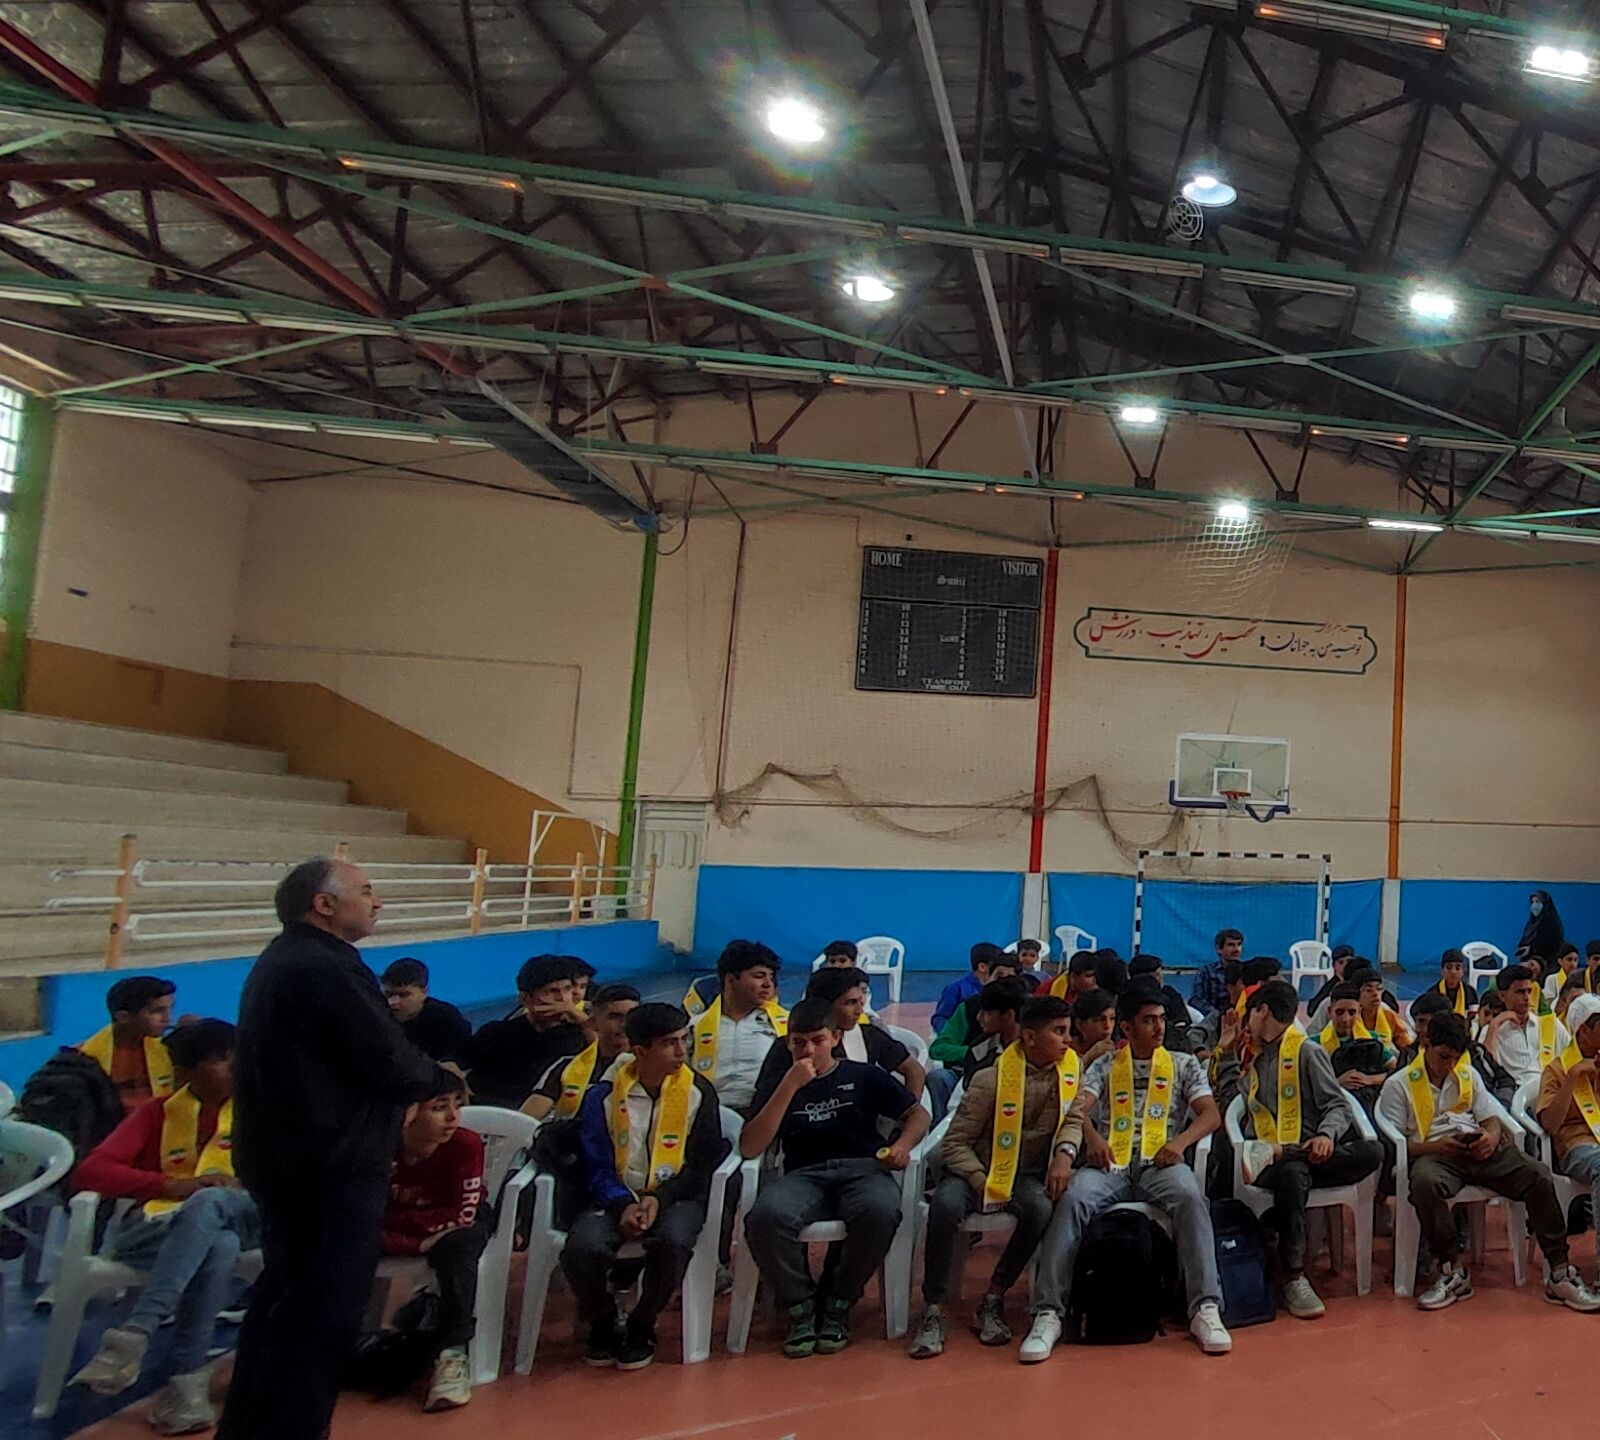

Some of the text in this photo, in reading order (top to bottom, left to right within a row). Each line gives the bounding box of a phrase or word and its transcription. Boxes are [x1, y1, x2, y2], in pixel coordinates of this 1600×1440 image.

[870, 551, 902, 567] HOME
[1001, 560, 1039, 577] VISITOR
[804, 1096, 840, 1112] Calvin
[808, 1109, 838, 1123] Klein
